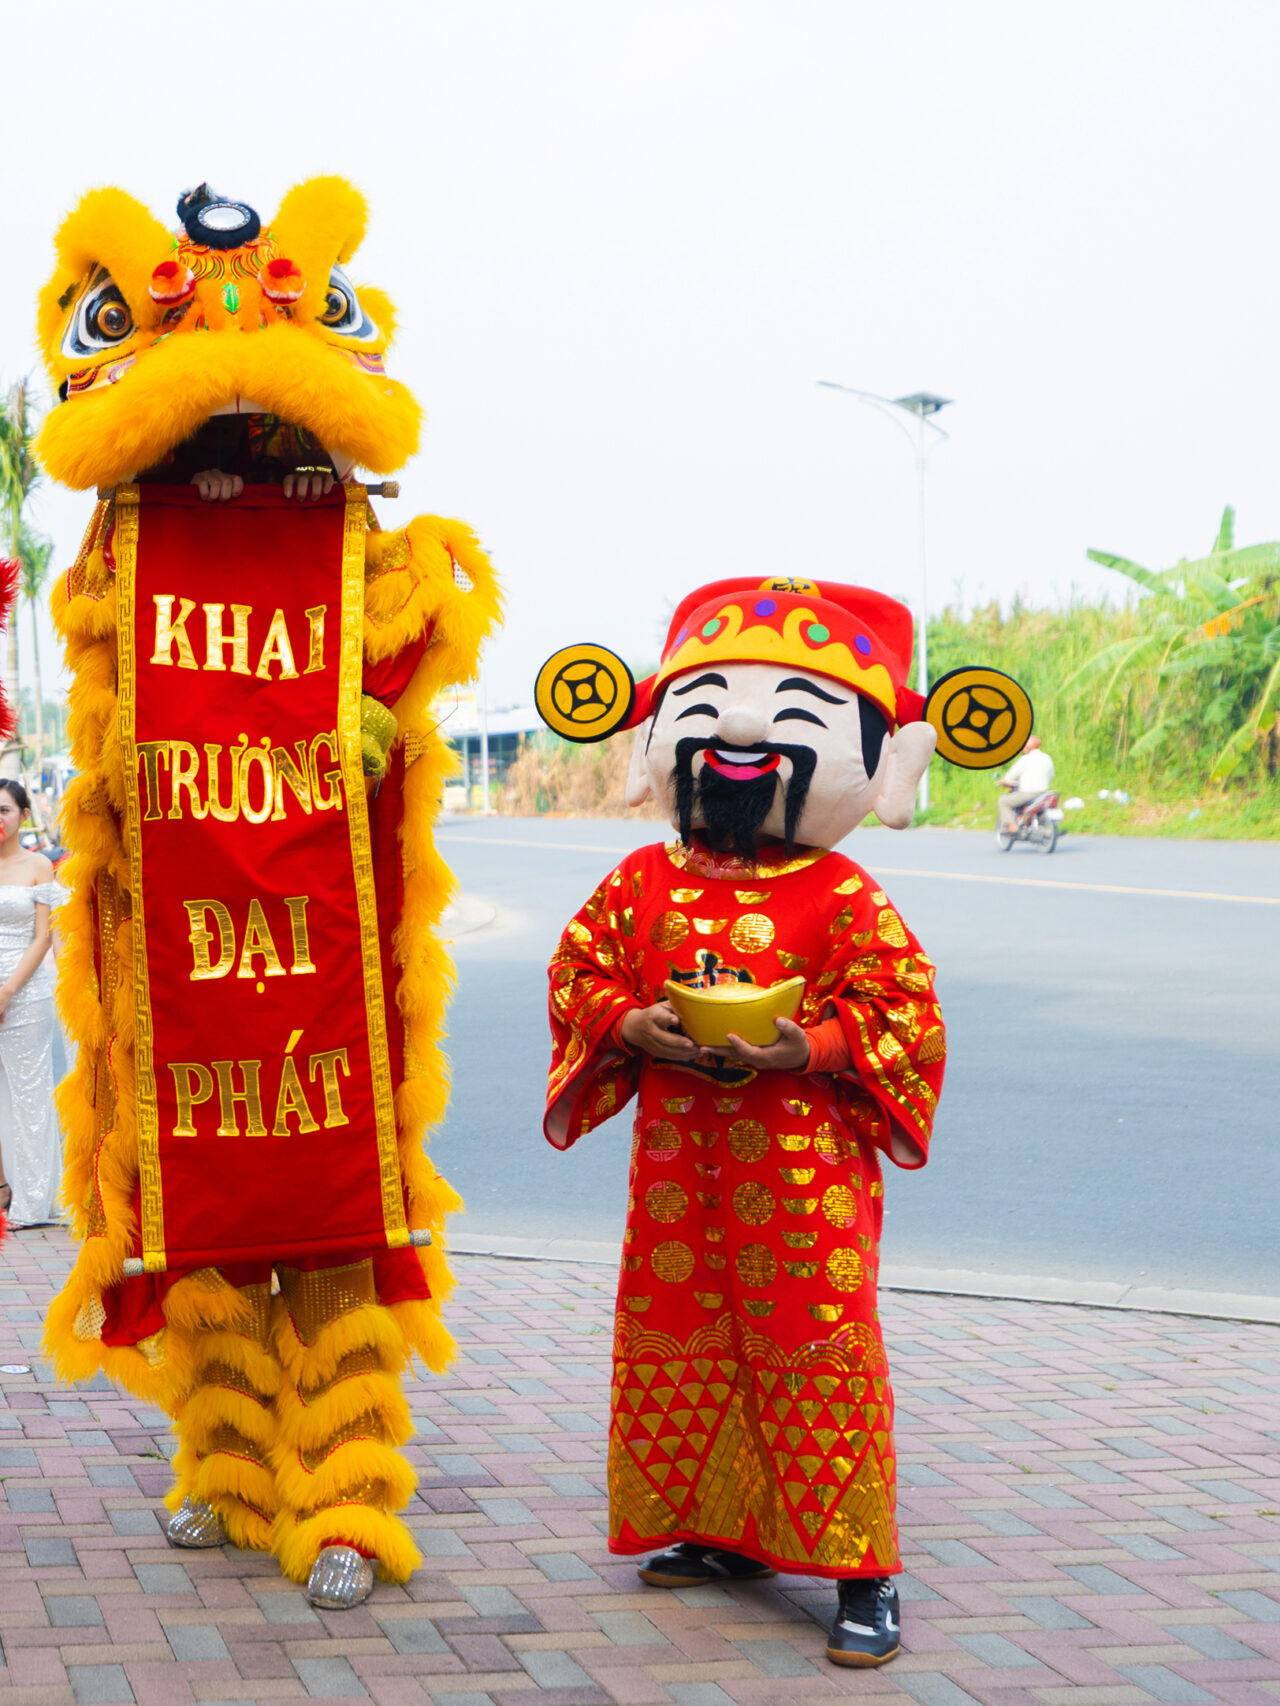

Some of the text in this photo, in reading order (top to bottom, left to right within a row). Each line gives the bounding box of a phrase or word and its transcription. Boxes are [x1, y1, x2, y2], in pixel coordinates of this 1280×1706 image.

[150, 594, 328, 680] KHAI
[137, 731, 344, 824] TRƯƠNG
[183, 896, 317, 994] ĐẠI
[168, 1030, 350, 1138] PHÁT
